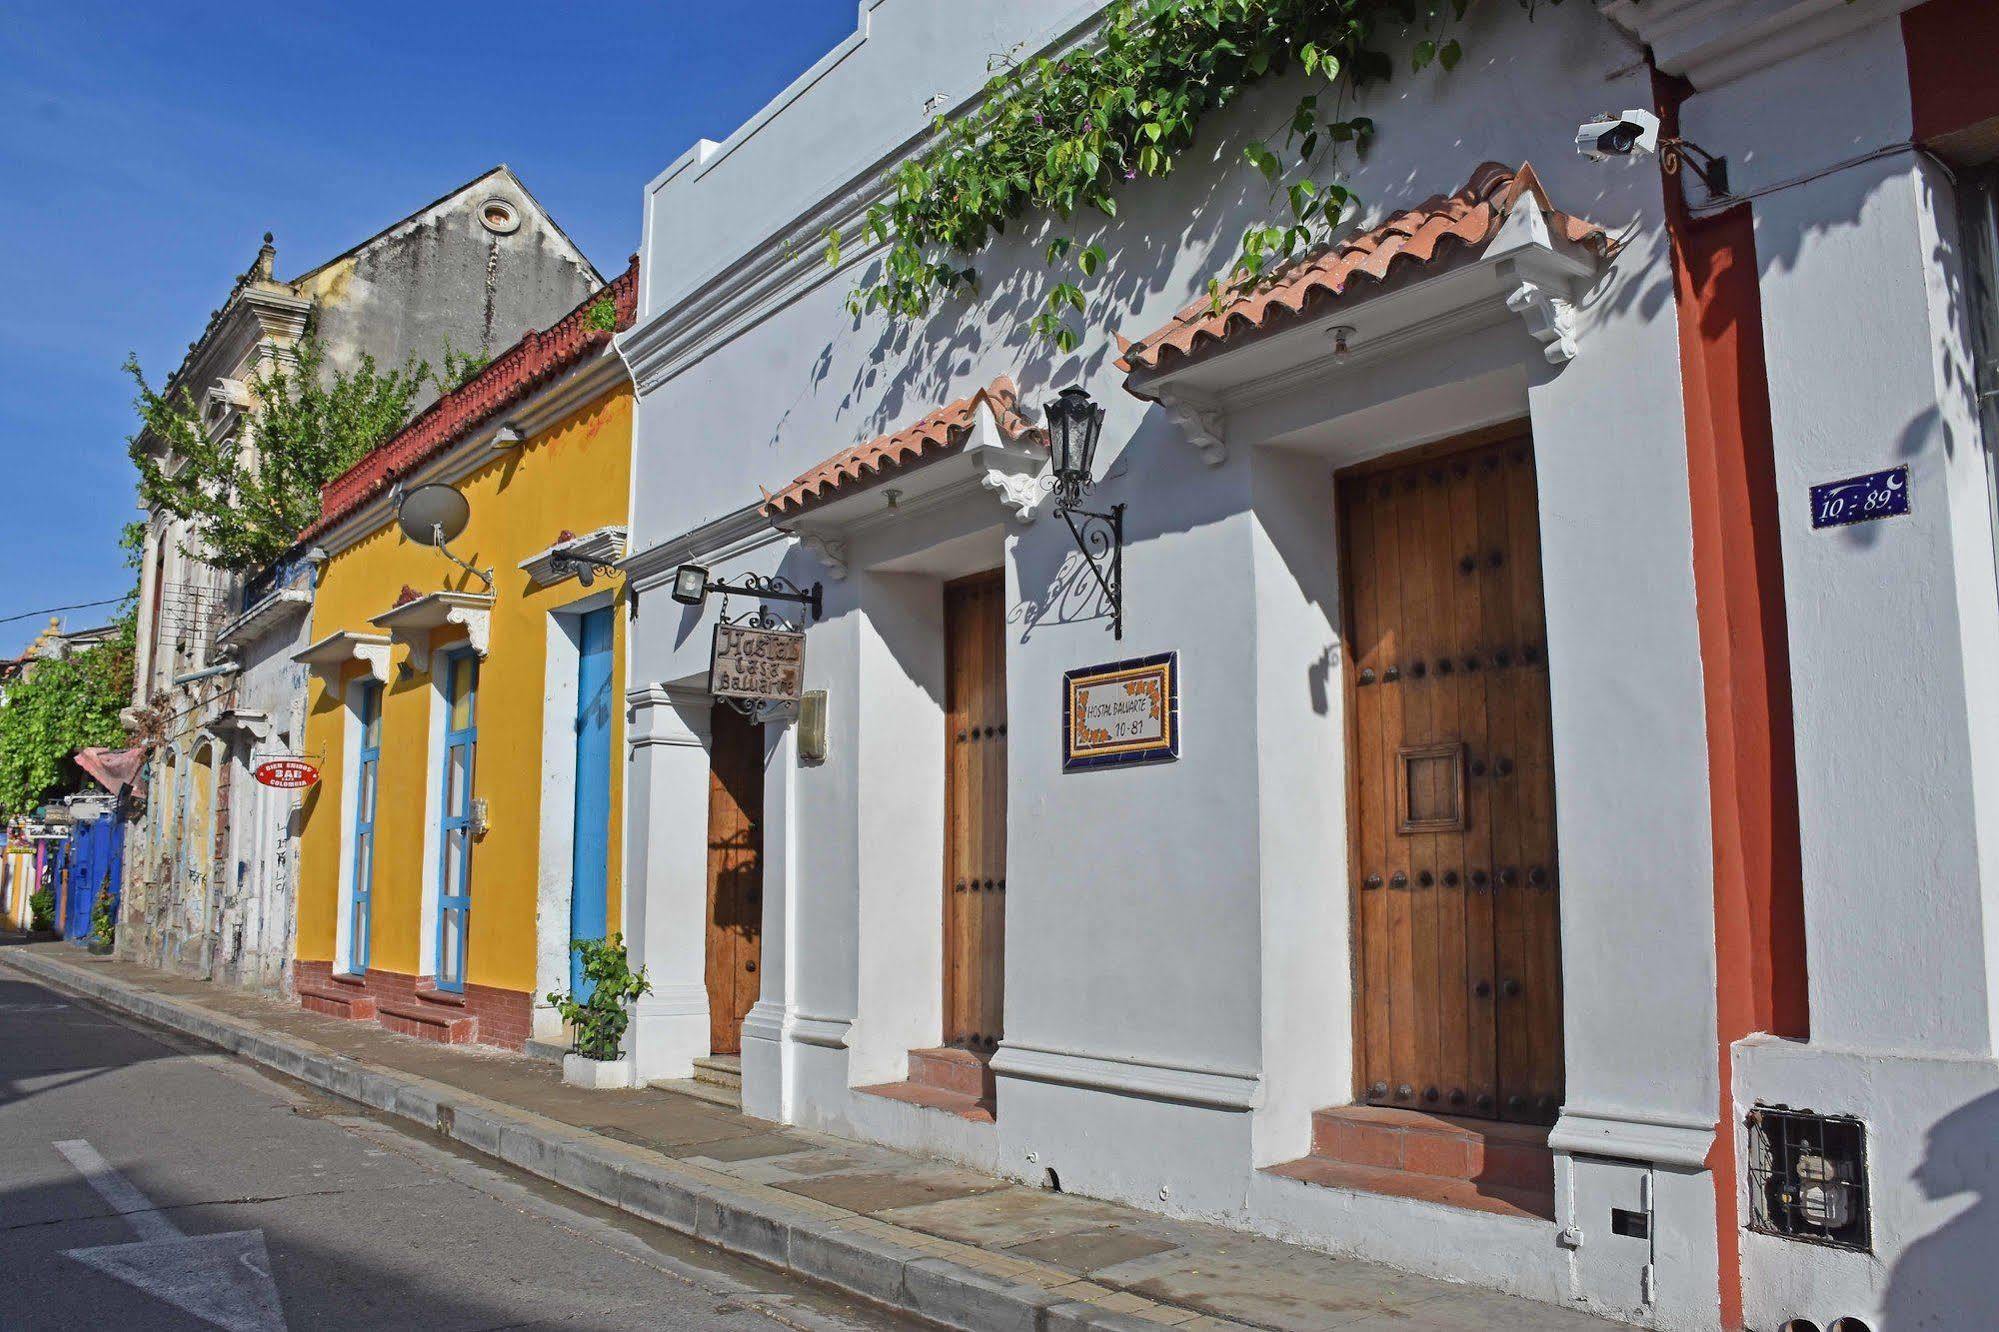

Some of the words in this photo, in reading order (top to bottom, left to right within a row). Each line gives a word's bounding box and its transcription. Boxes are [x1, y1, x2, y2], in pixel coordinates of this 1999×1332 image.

[735, 656, 779, 678] Casa
[719, 671, 795, 696] Baluarte
[1087, 702, 1112, 718] HOSTAL
[1115, 719, 1143, 737] 10-81
